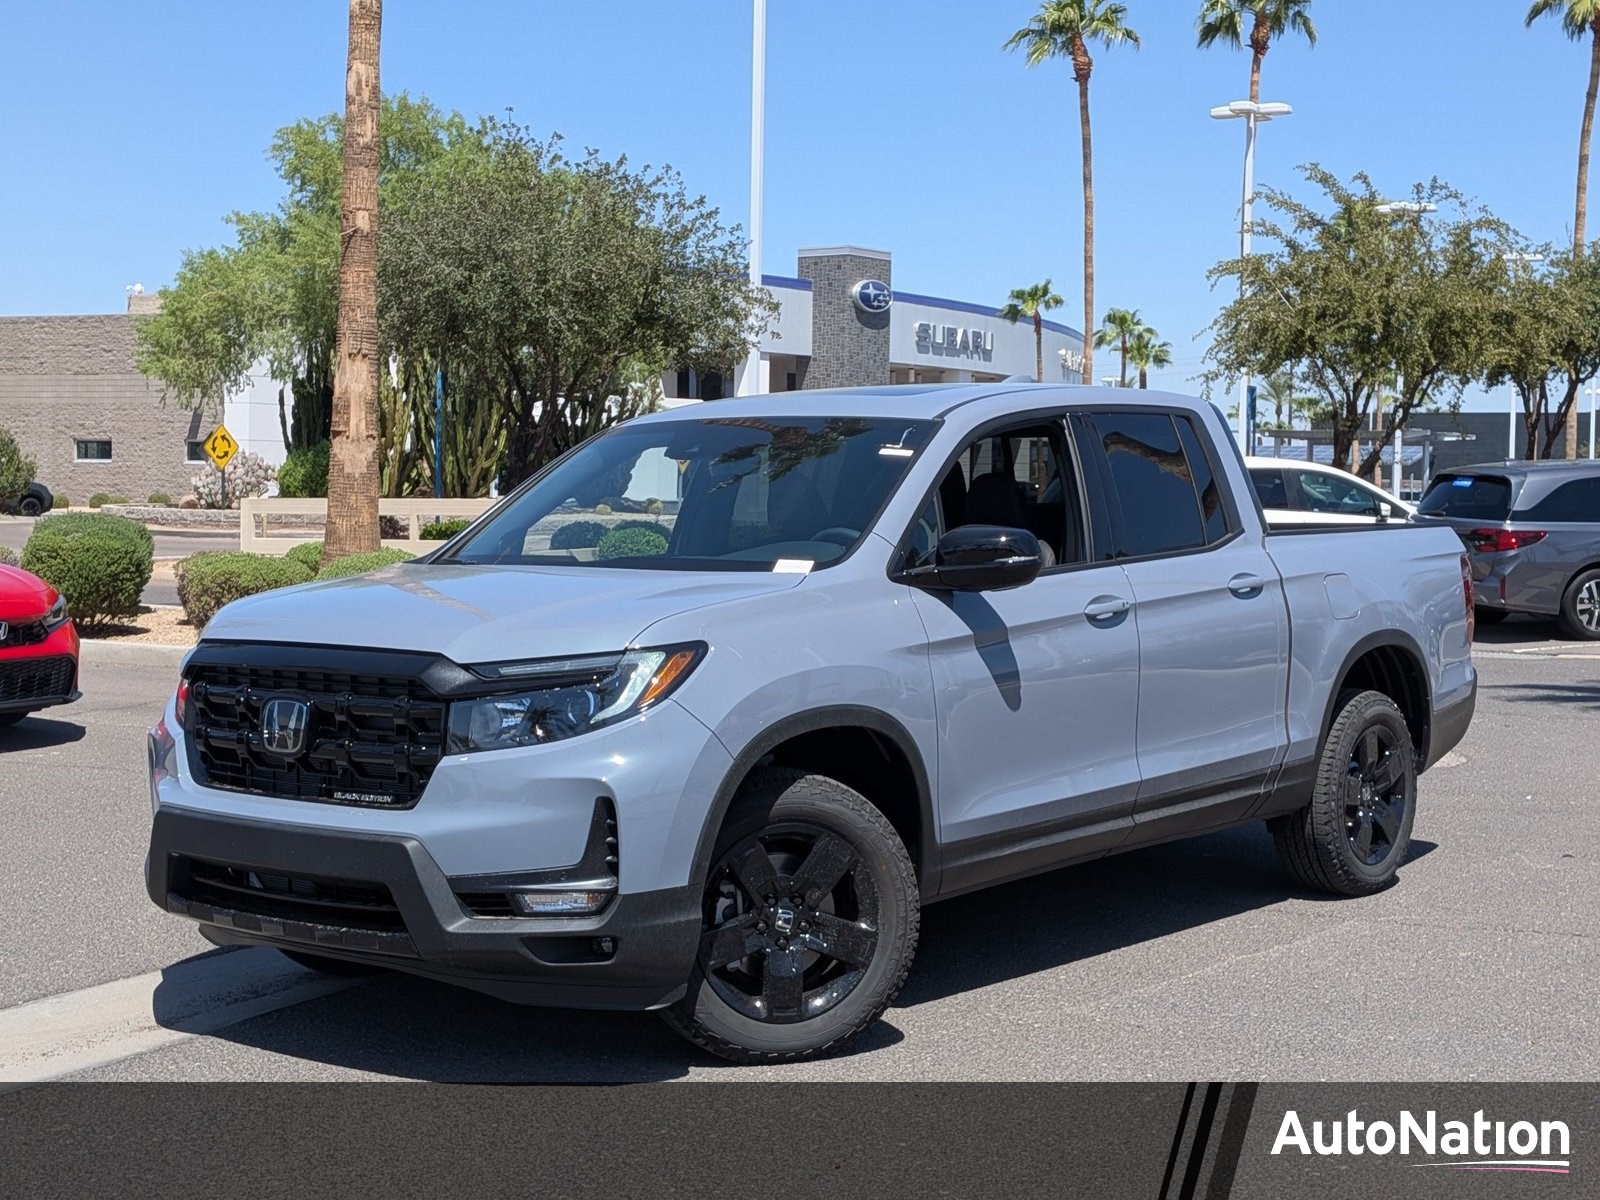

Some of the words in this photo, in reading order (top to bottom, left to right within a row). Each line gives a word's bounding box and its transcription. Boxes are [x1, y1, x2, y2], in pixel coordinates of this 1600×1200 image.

[913, 322, 994, 354] SUBARU
[333, 792, 360, 800] BLACK
[361, 794, 393, 803] EDITION
